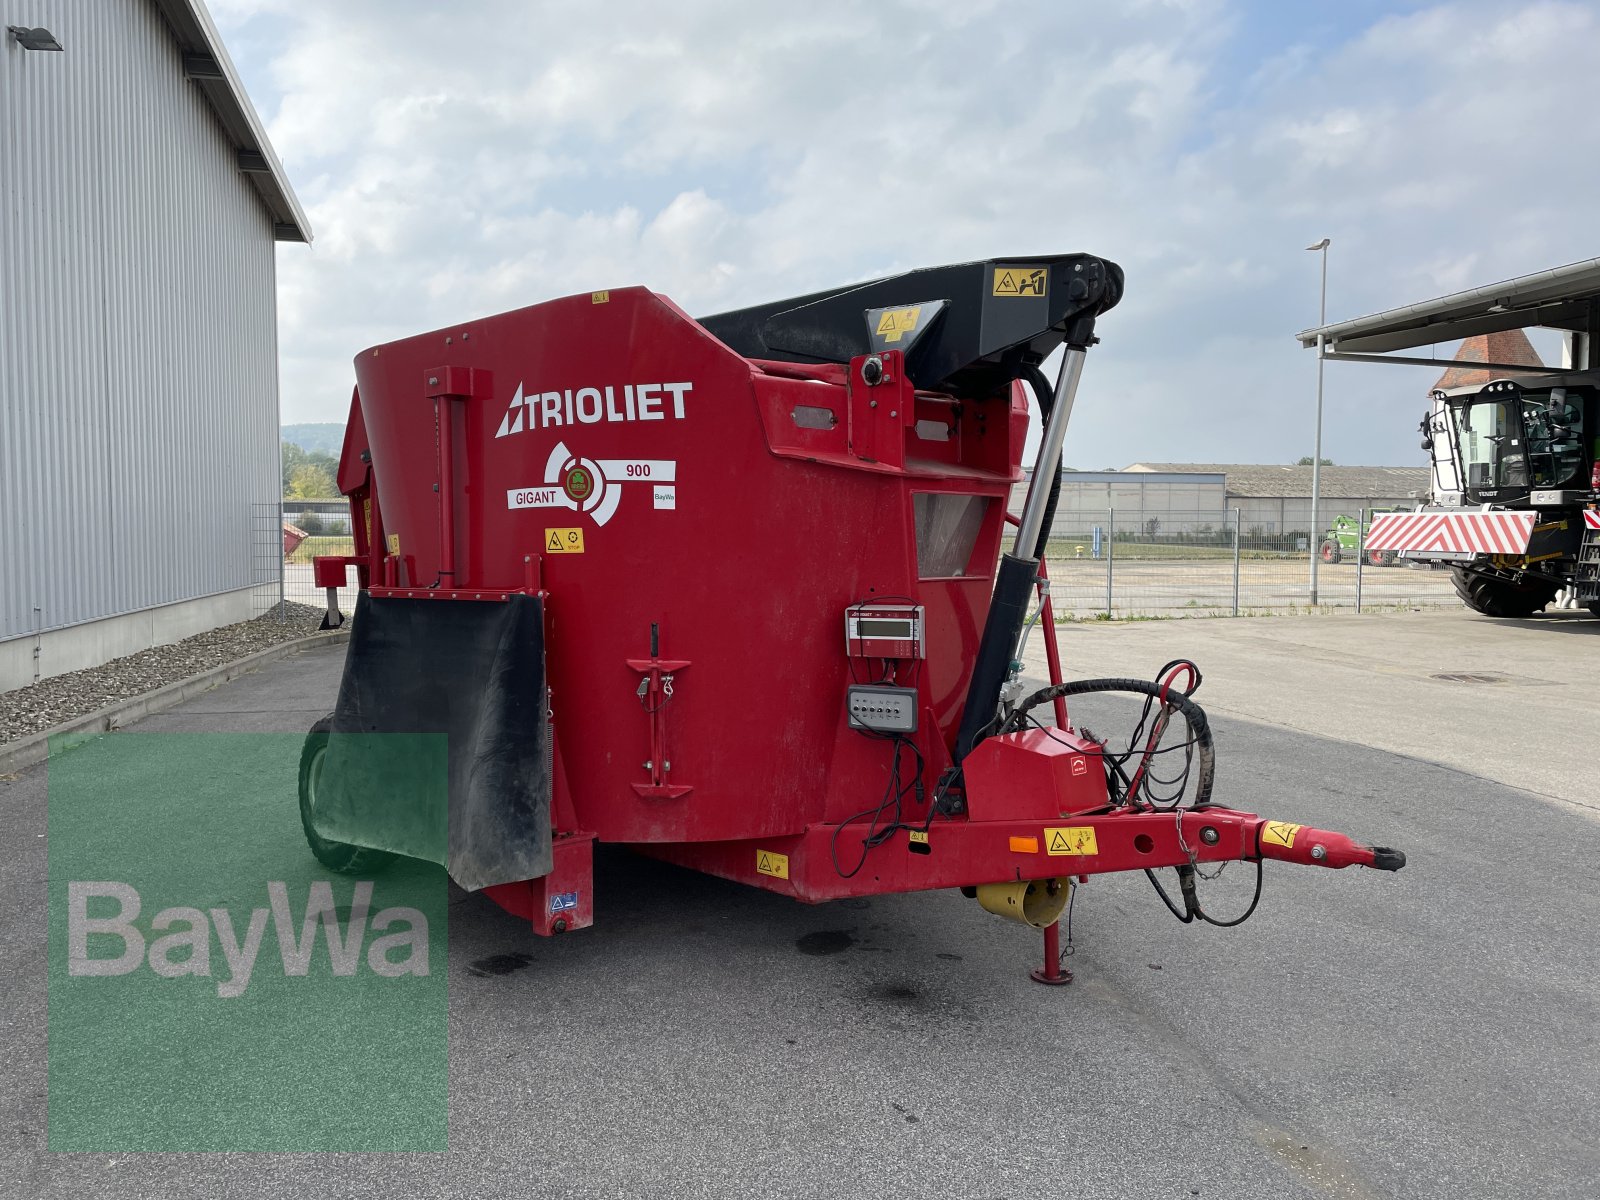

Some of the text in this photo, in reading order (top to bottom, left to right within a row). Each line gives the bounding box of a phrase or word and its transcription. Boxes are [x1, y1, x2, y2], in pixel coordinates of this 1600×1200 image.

[524, 382, 693, 430] TRIOLIET
[626, 464, 651, 477] 900
[516, 491, 557, 505] GIGANT
[654, 493, 675, 501] BayWa
